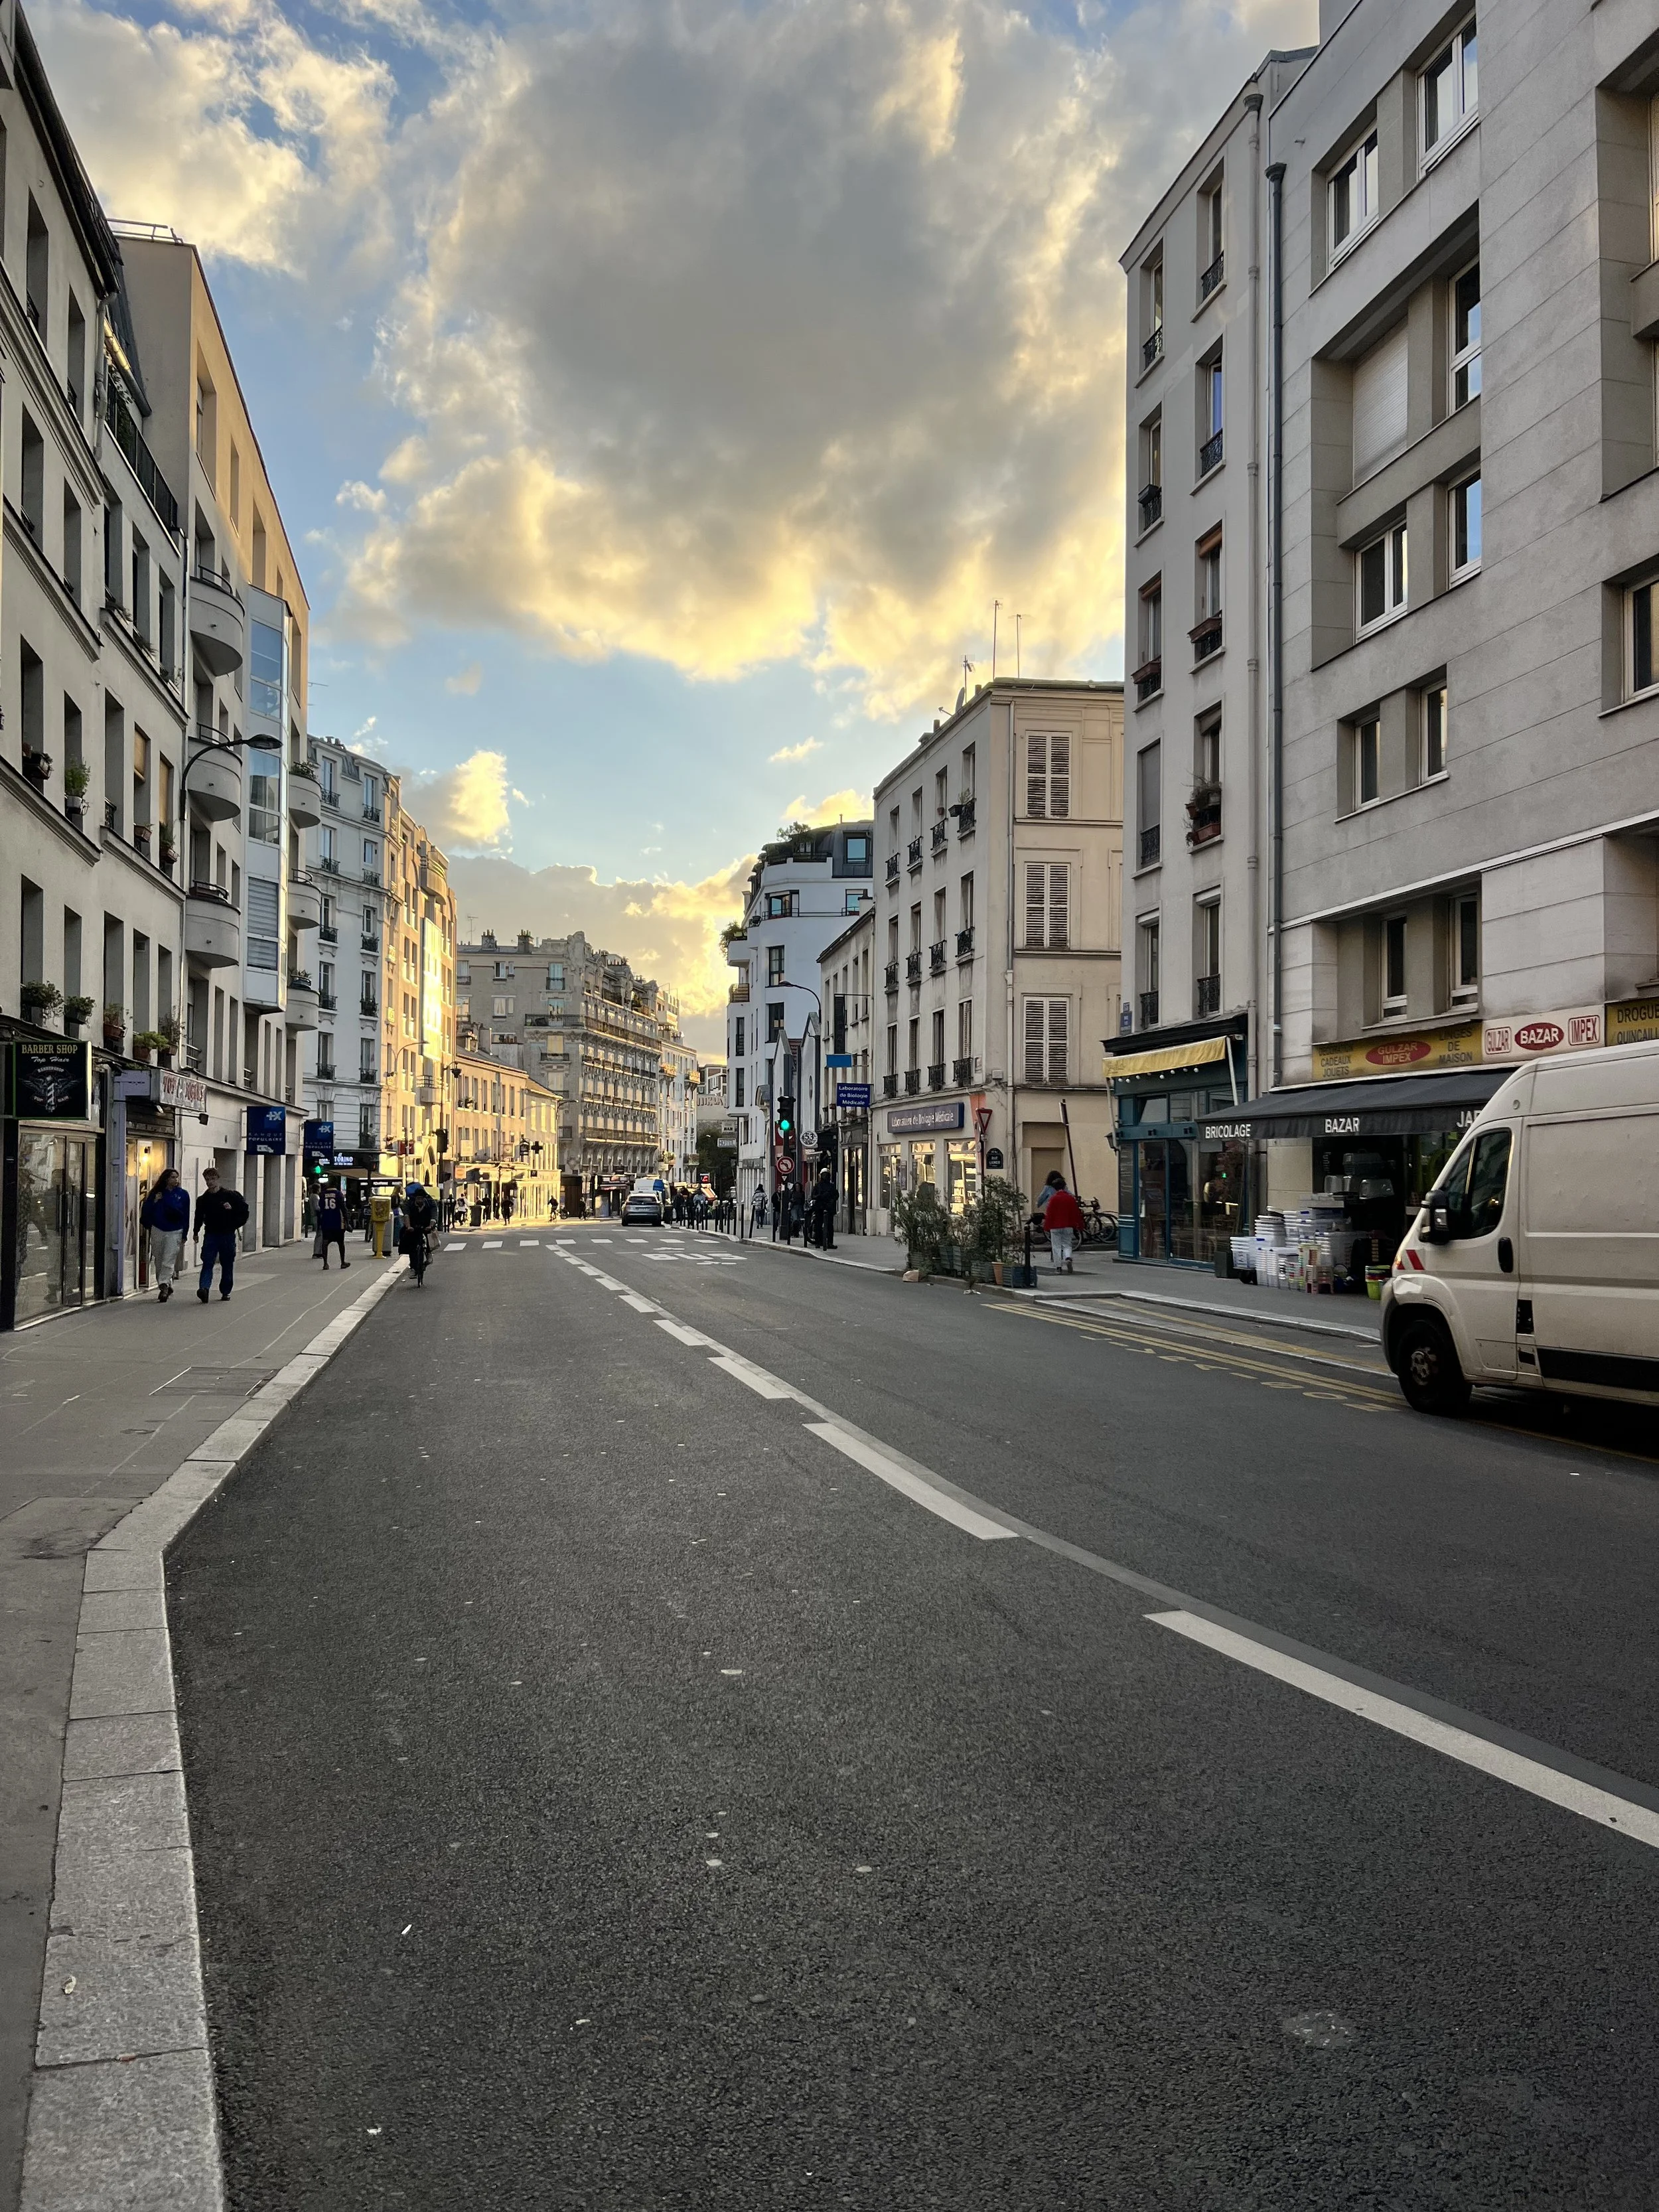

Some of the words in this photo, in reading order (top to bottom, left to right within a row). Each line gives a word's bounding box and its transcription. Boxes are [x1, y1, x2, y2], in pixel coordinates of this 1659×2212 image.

[1487, 1030, 1510, 1053] GULZAR
[1520, 1028, 1560, 1045] BAZAR
[1571, 1017, 1598, 1043] IMPEX
[21, 1044, 54, 1054] BARBER
[56, 1044, 78, 1054] SHOP
[1377, 1043, 1418, 1055] GULZAR
[1447, 1041, 1461, 1052] DE
[1321, 1055, 1352, 1067] CADEAUX
[1382, 1053, 1412, 1065] IMPEX
[1439, 1051, 1473, 1065] MAISON
[1323, 1066, 1350, 1078] JOUETS
[1205, 1124, 1251, 1139] BRICOLAGE
[1325, 1117, 1360, 1133] BAZAR
[802, 1132, 814, 1140] 53
[325, 1198, 336, 1209] 16
[1080, 1335, 1401, 1412] LIVRAISON
